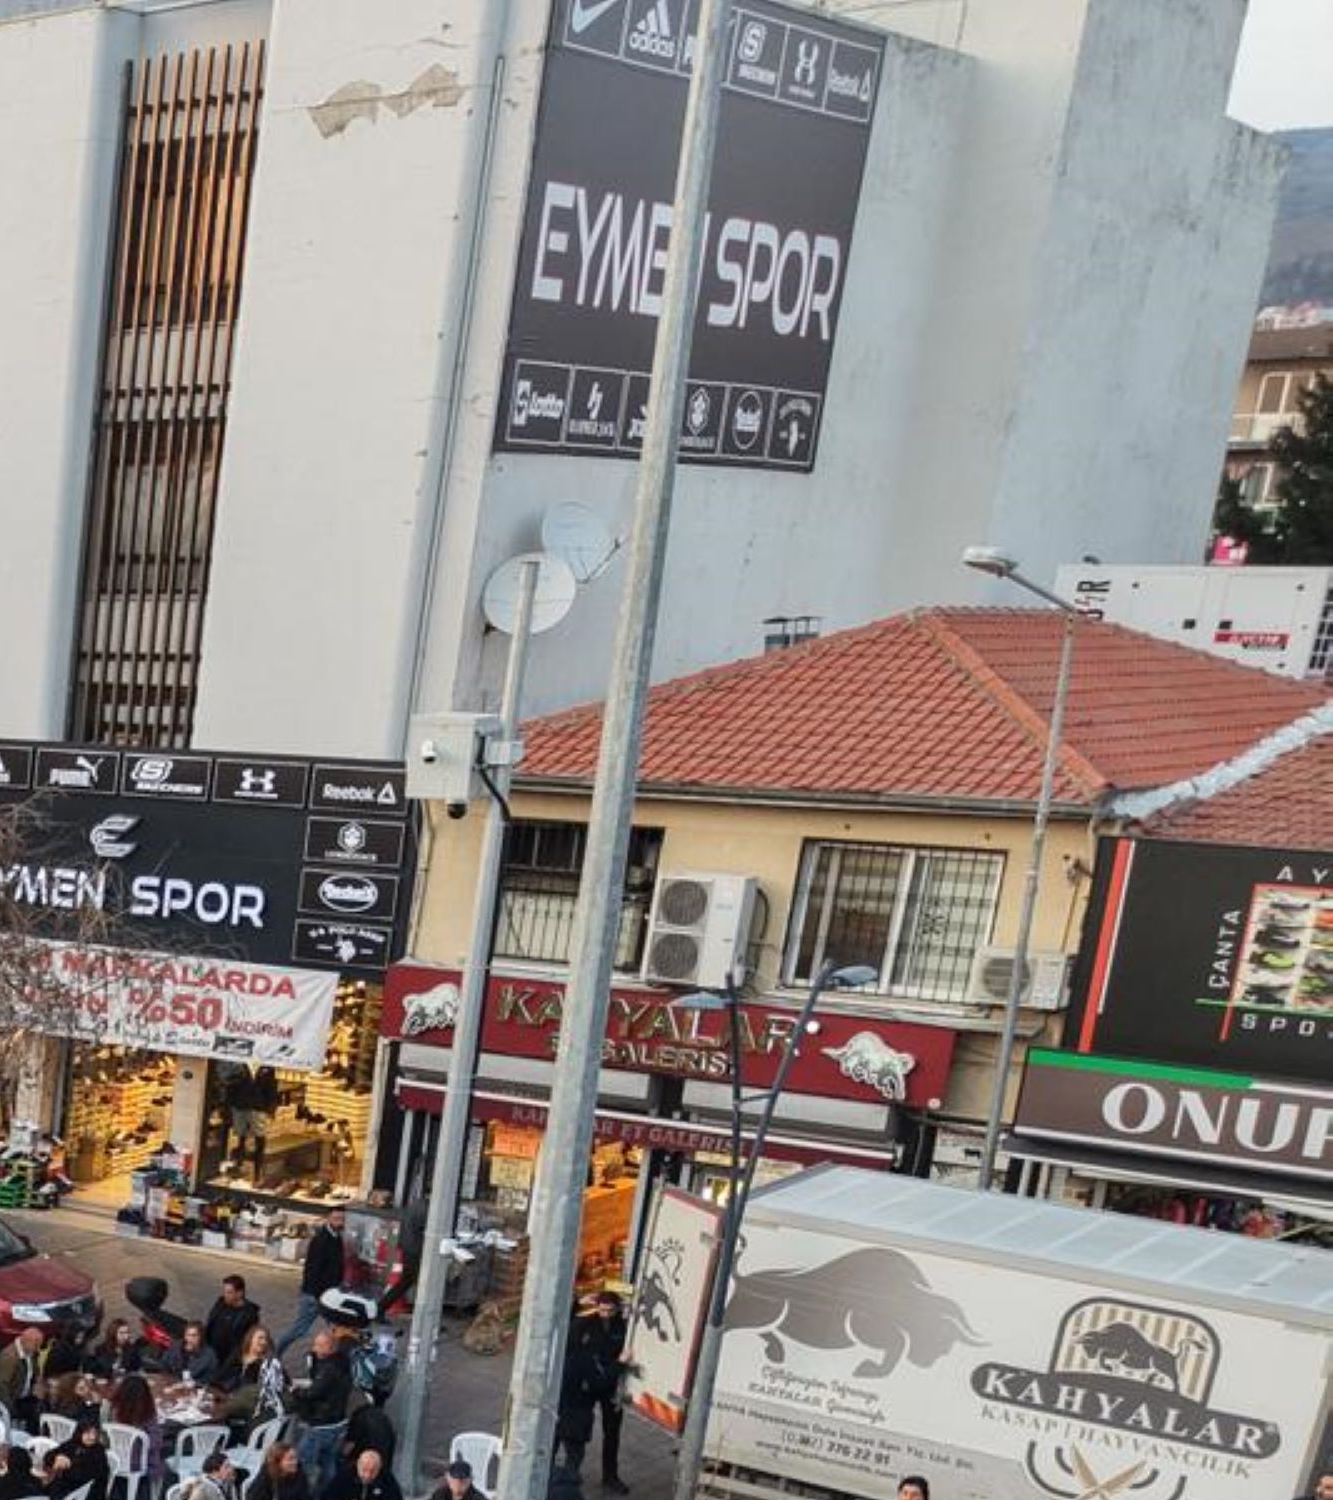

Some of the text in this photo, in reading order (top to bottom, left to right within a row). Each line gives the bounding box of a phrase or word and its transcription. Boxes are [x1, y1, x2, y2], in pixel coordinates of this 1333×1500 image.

[628, 31, 676, 58] adidas
[532, 181, 840, 341] EYME SPOR
[49, 768, 91, 787] PUMA
[322, 782, 375, 801] Reebok
[129, 875, 264, 928] SPOR
[1208, 909, 1241, 990] ÇANTA
[129, 984, 223, 1031] %50
[496, 984, 801, 1057] KAYALAR
[1241, 1013, 1333, 1038] SPO
[983, 1367, 1265, 1453] KAHYALAR
[981, 1403, 1252, 1479] KASAP HAYVANCILIK
